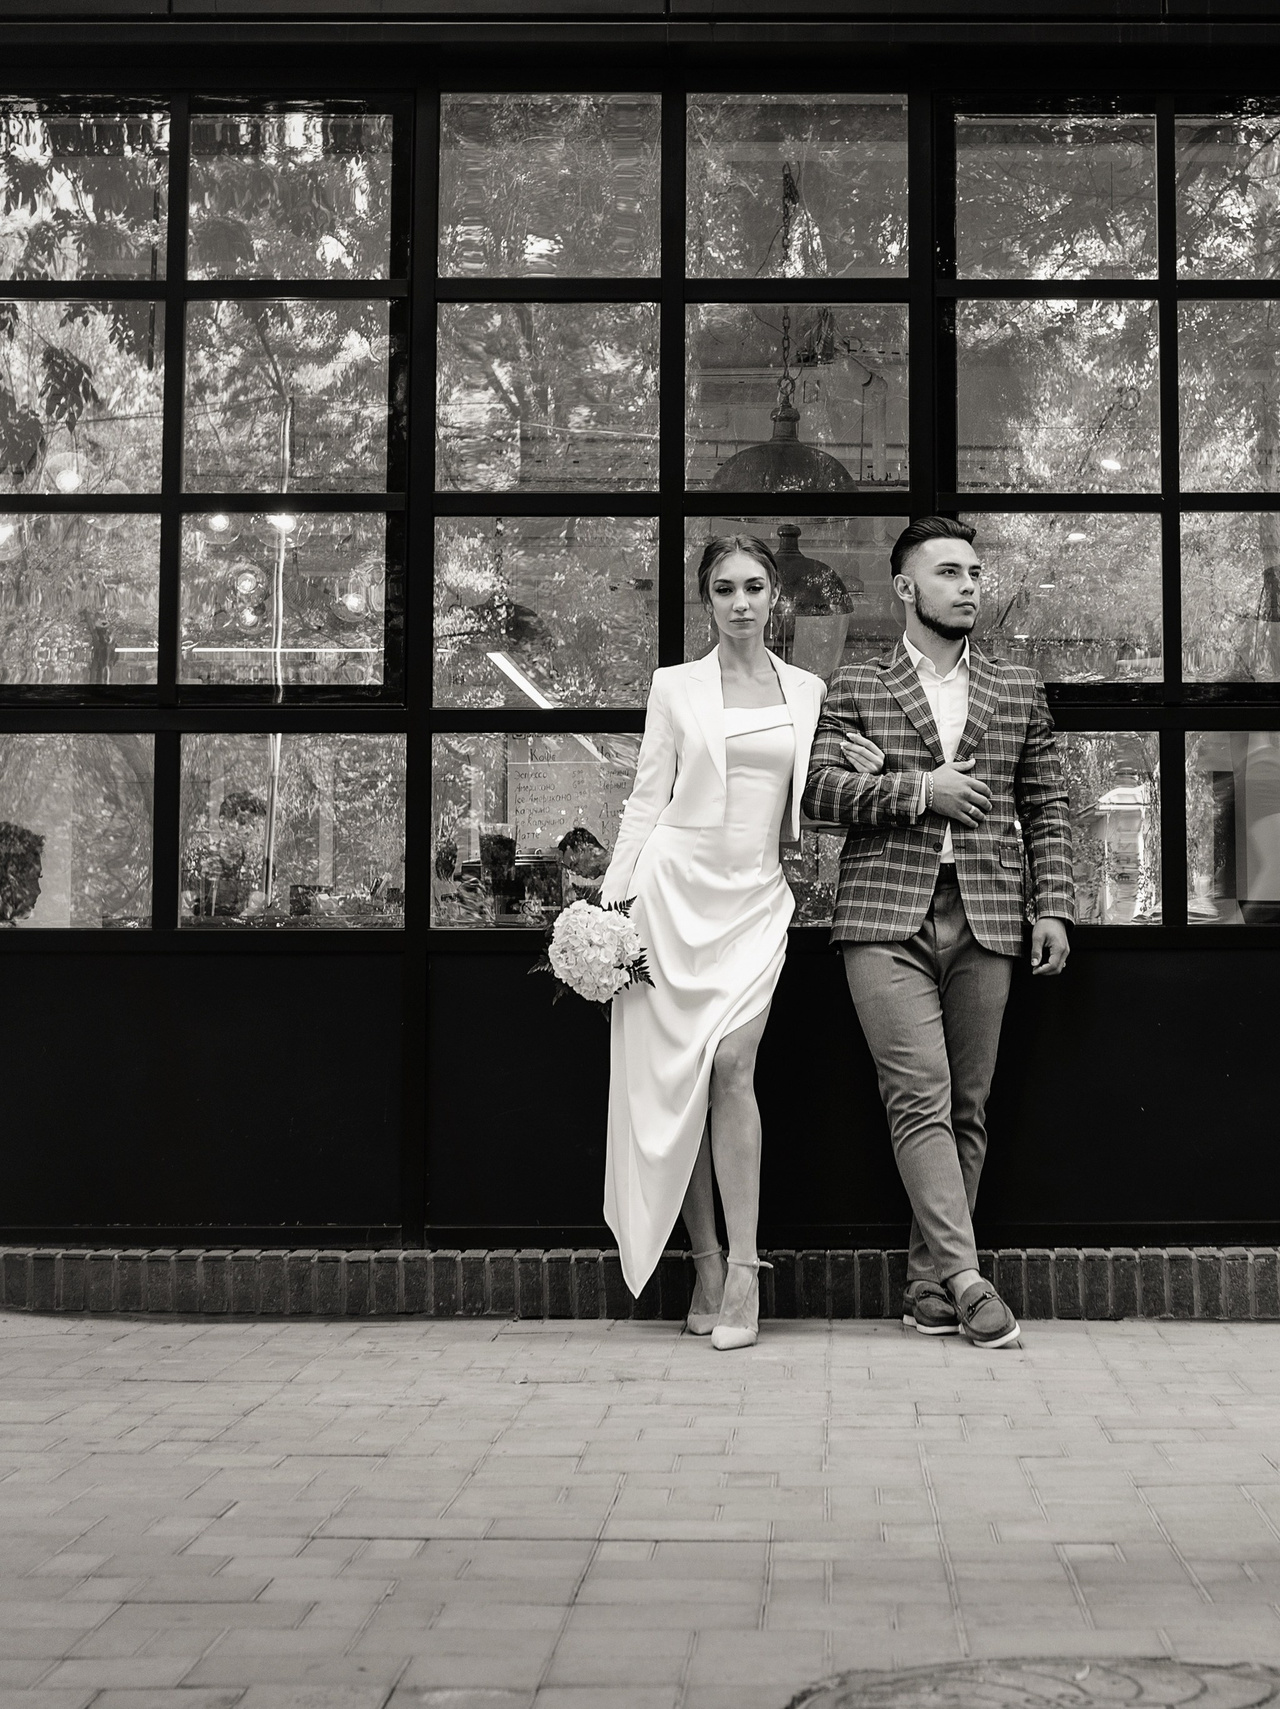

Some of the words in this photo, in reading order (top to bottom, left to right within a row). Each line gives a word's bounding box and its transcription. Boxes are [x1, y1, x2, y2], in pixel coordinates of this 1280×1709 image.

[530, 745, 556, 766] Кофе
[514, 782, 556, 797] Американо
[528, 793, 572, 807] Американо
